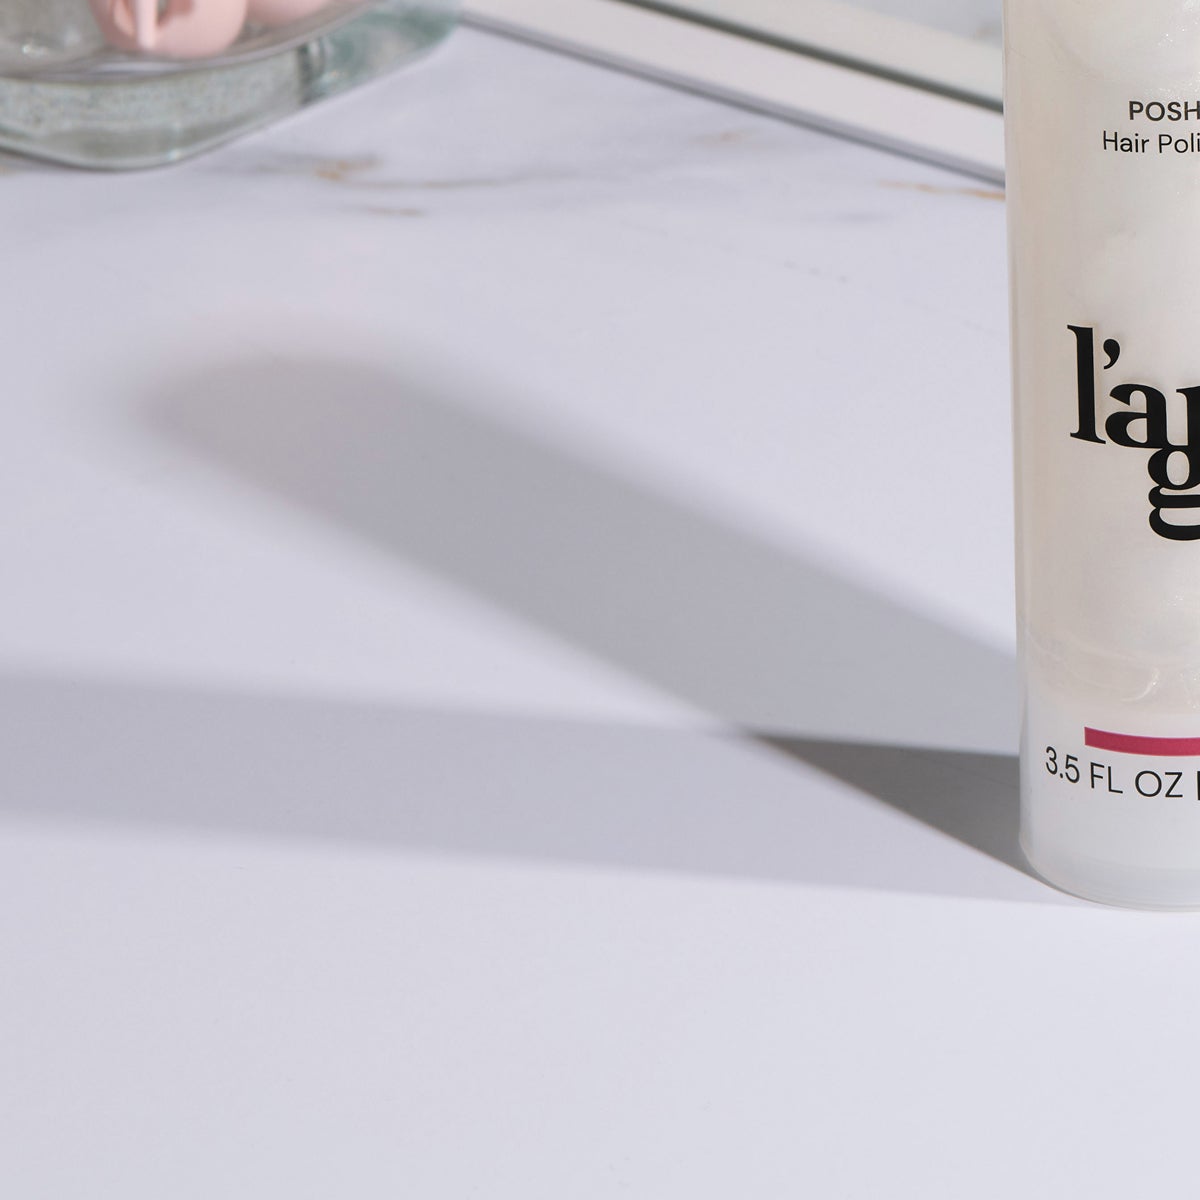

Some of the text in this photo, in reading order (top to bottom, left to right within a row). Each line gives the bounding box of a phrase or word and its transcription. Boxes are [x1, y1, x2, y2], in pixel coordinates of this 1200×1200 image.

[1128, 100, 1200, 121] POSH
[1103, 130, 1150, 153] Hair
[1045, 746, 1080, 784] 3.5
[1090, 761, 1123, 794] FL
[1134, 770, 1183, 798] OZ
